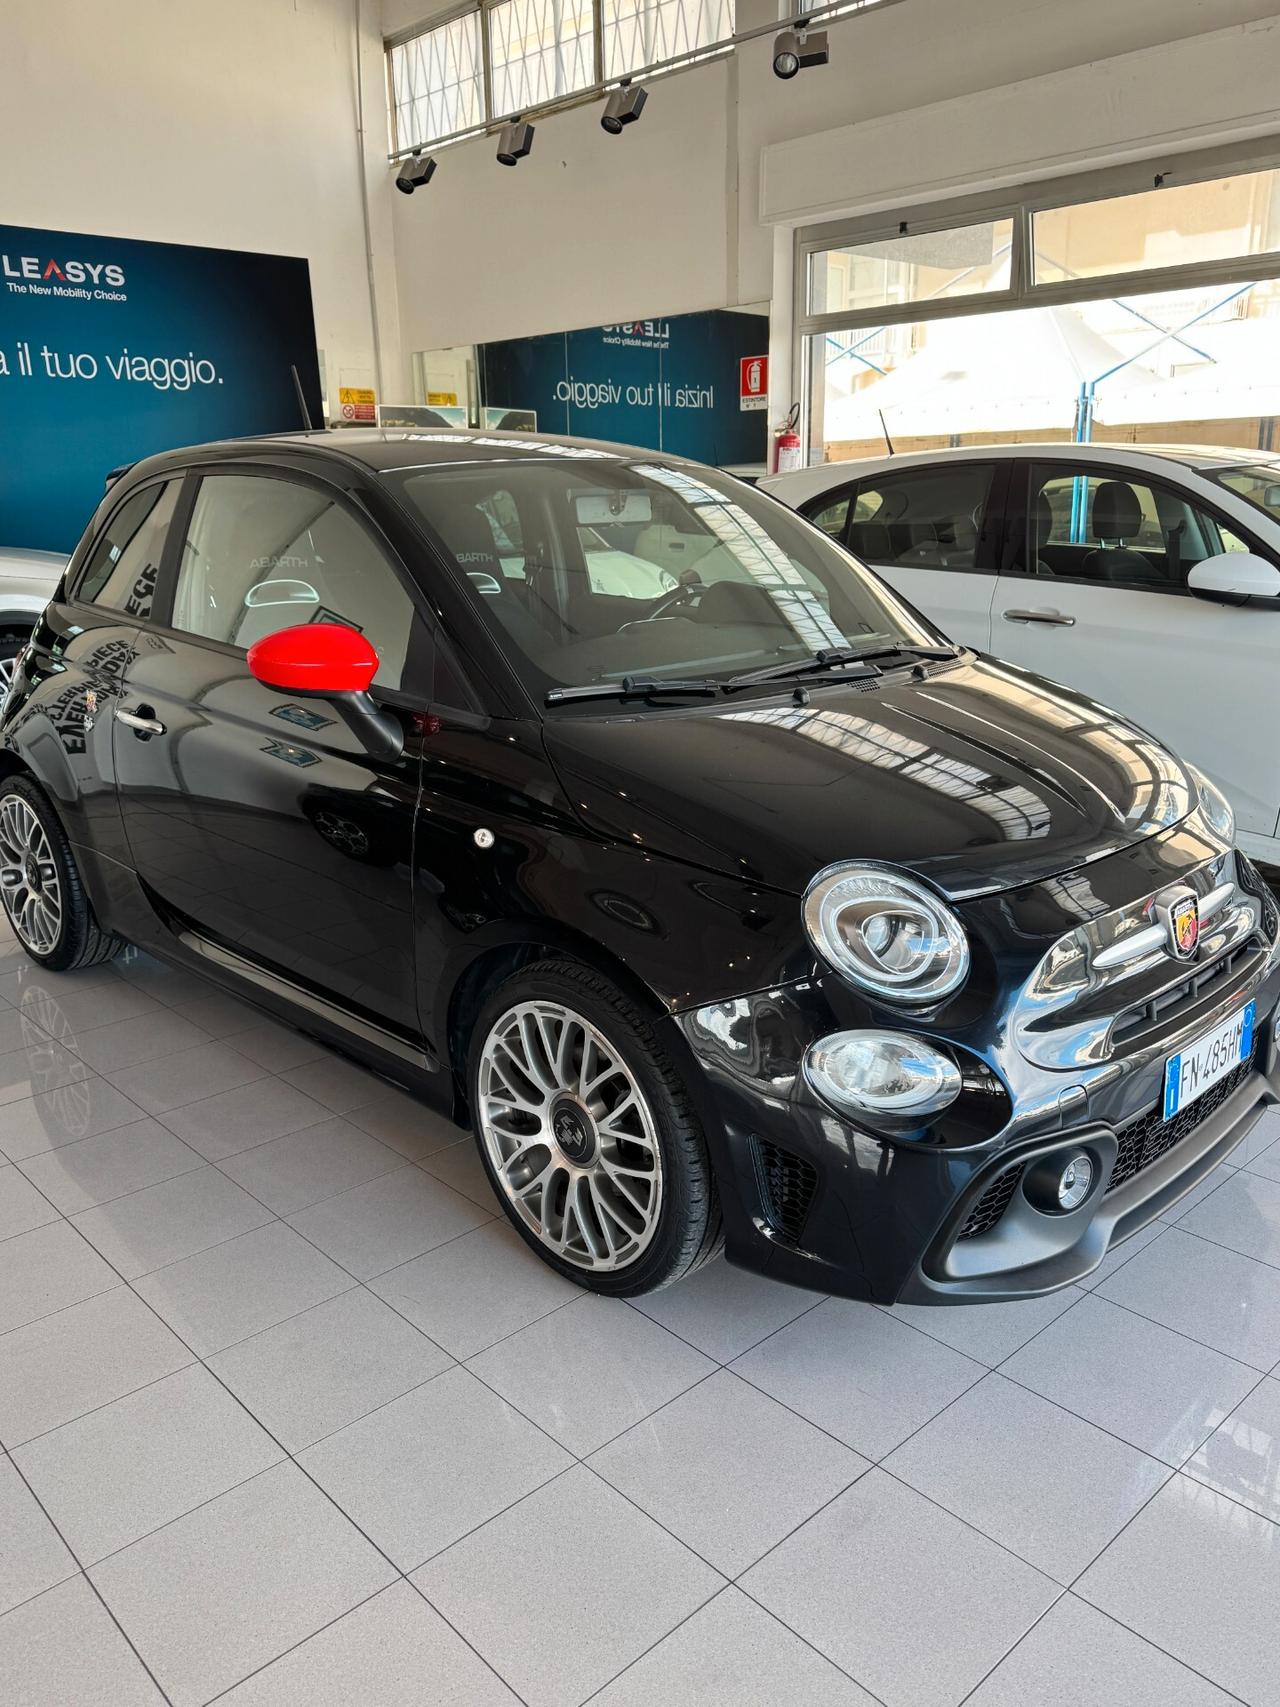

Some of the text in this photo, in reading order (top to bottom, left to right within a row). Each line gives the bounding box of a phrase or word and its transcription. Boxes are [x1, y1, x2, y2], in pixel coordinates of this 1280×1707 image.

[2, 255, 125, 286] LEASYS
[7, 282, 127, 301] The New Mobility Choice
[17, 342, 32, 376] il
[40, 345, 97, 379] tuo
[105, 348, 224, 391] viaggio.
[250, 556, 308, 568] ABARTH
[457, 553, 493, 562] BARTH
